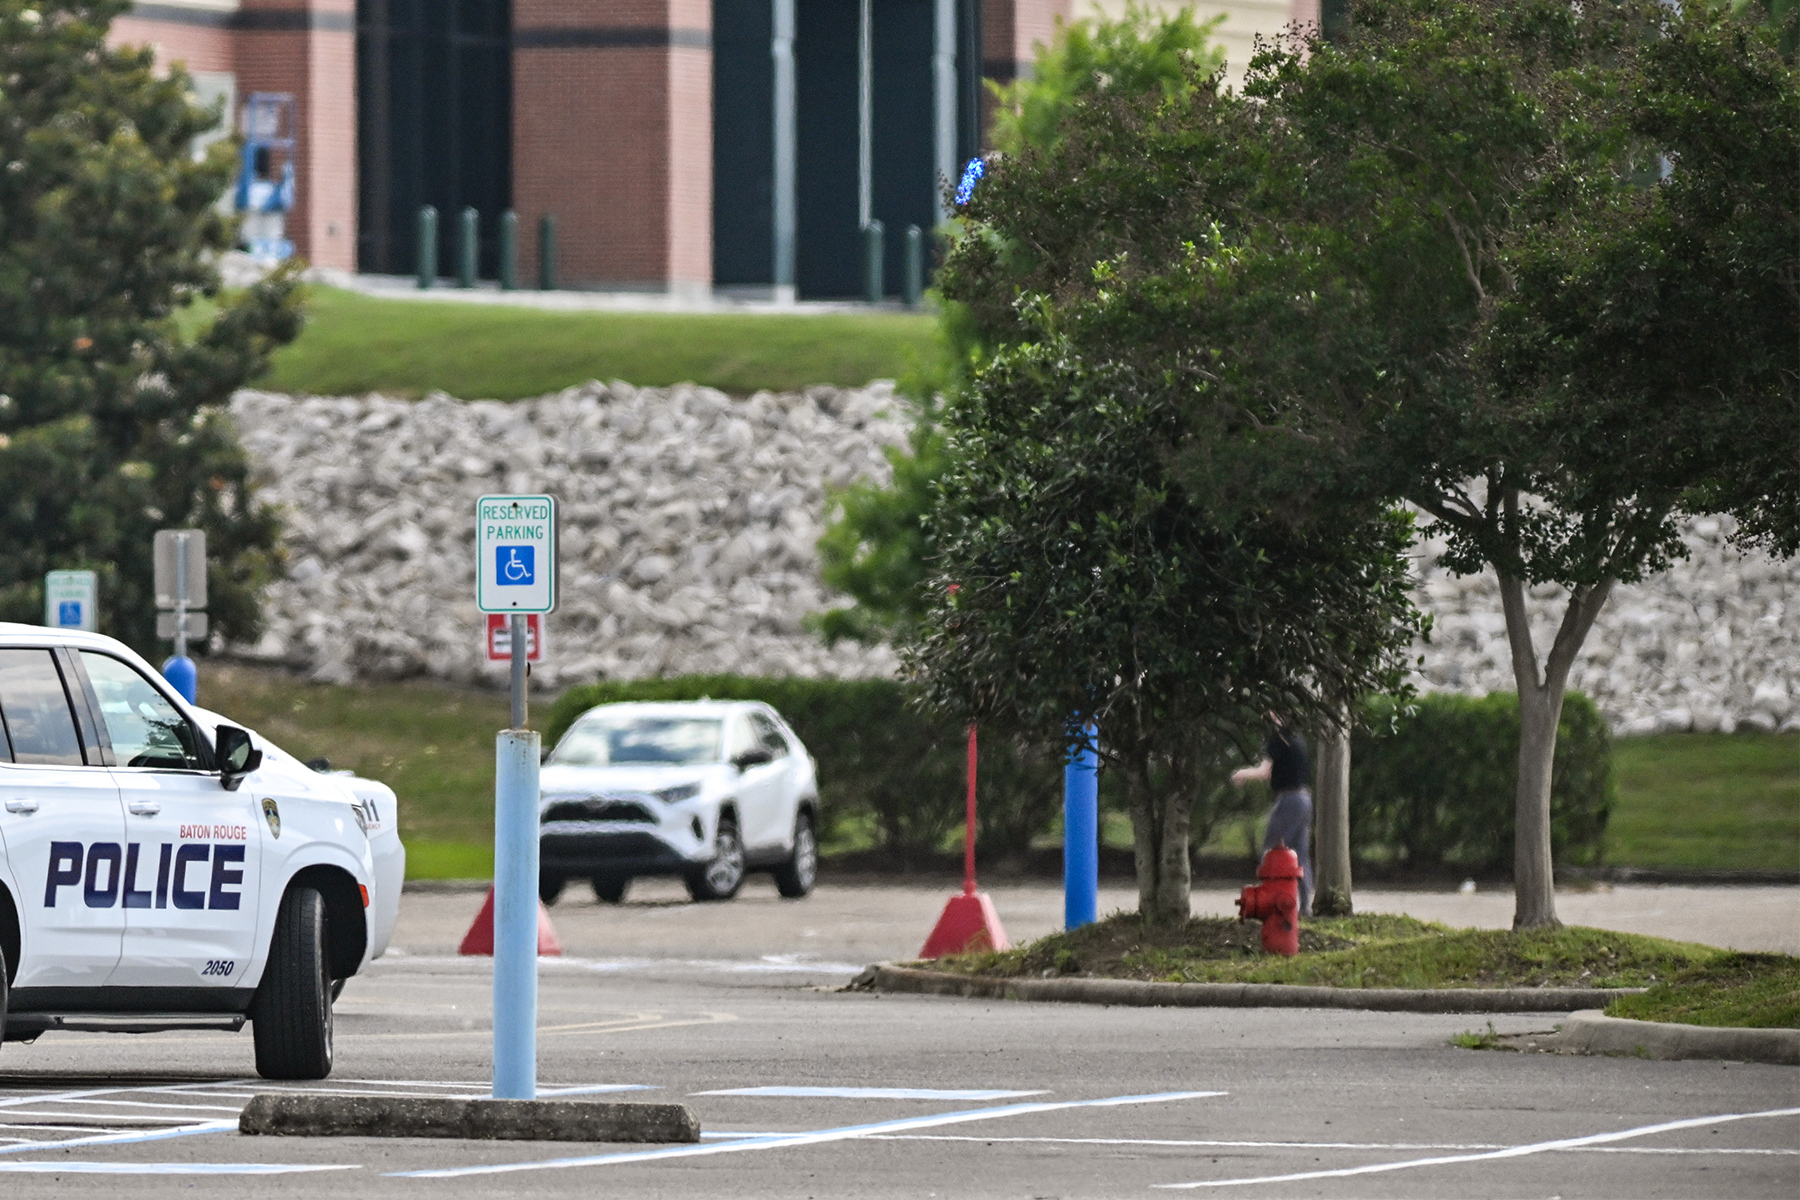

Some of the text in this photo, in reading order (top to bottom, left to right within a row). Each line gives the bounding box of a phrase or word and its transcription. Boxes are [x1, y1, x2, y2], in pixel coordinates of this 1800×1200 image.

[483, 505, 548, 520] RESERVED
[487, 525, 544, 540] PARKING
[180, 824, 247, 840] BATON ROUGE
[44, 841, 246, 911] POLICE
[201, 960, 235, 977] 2050
